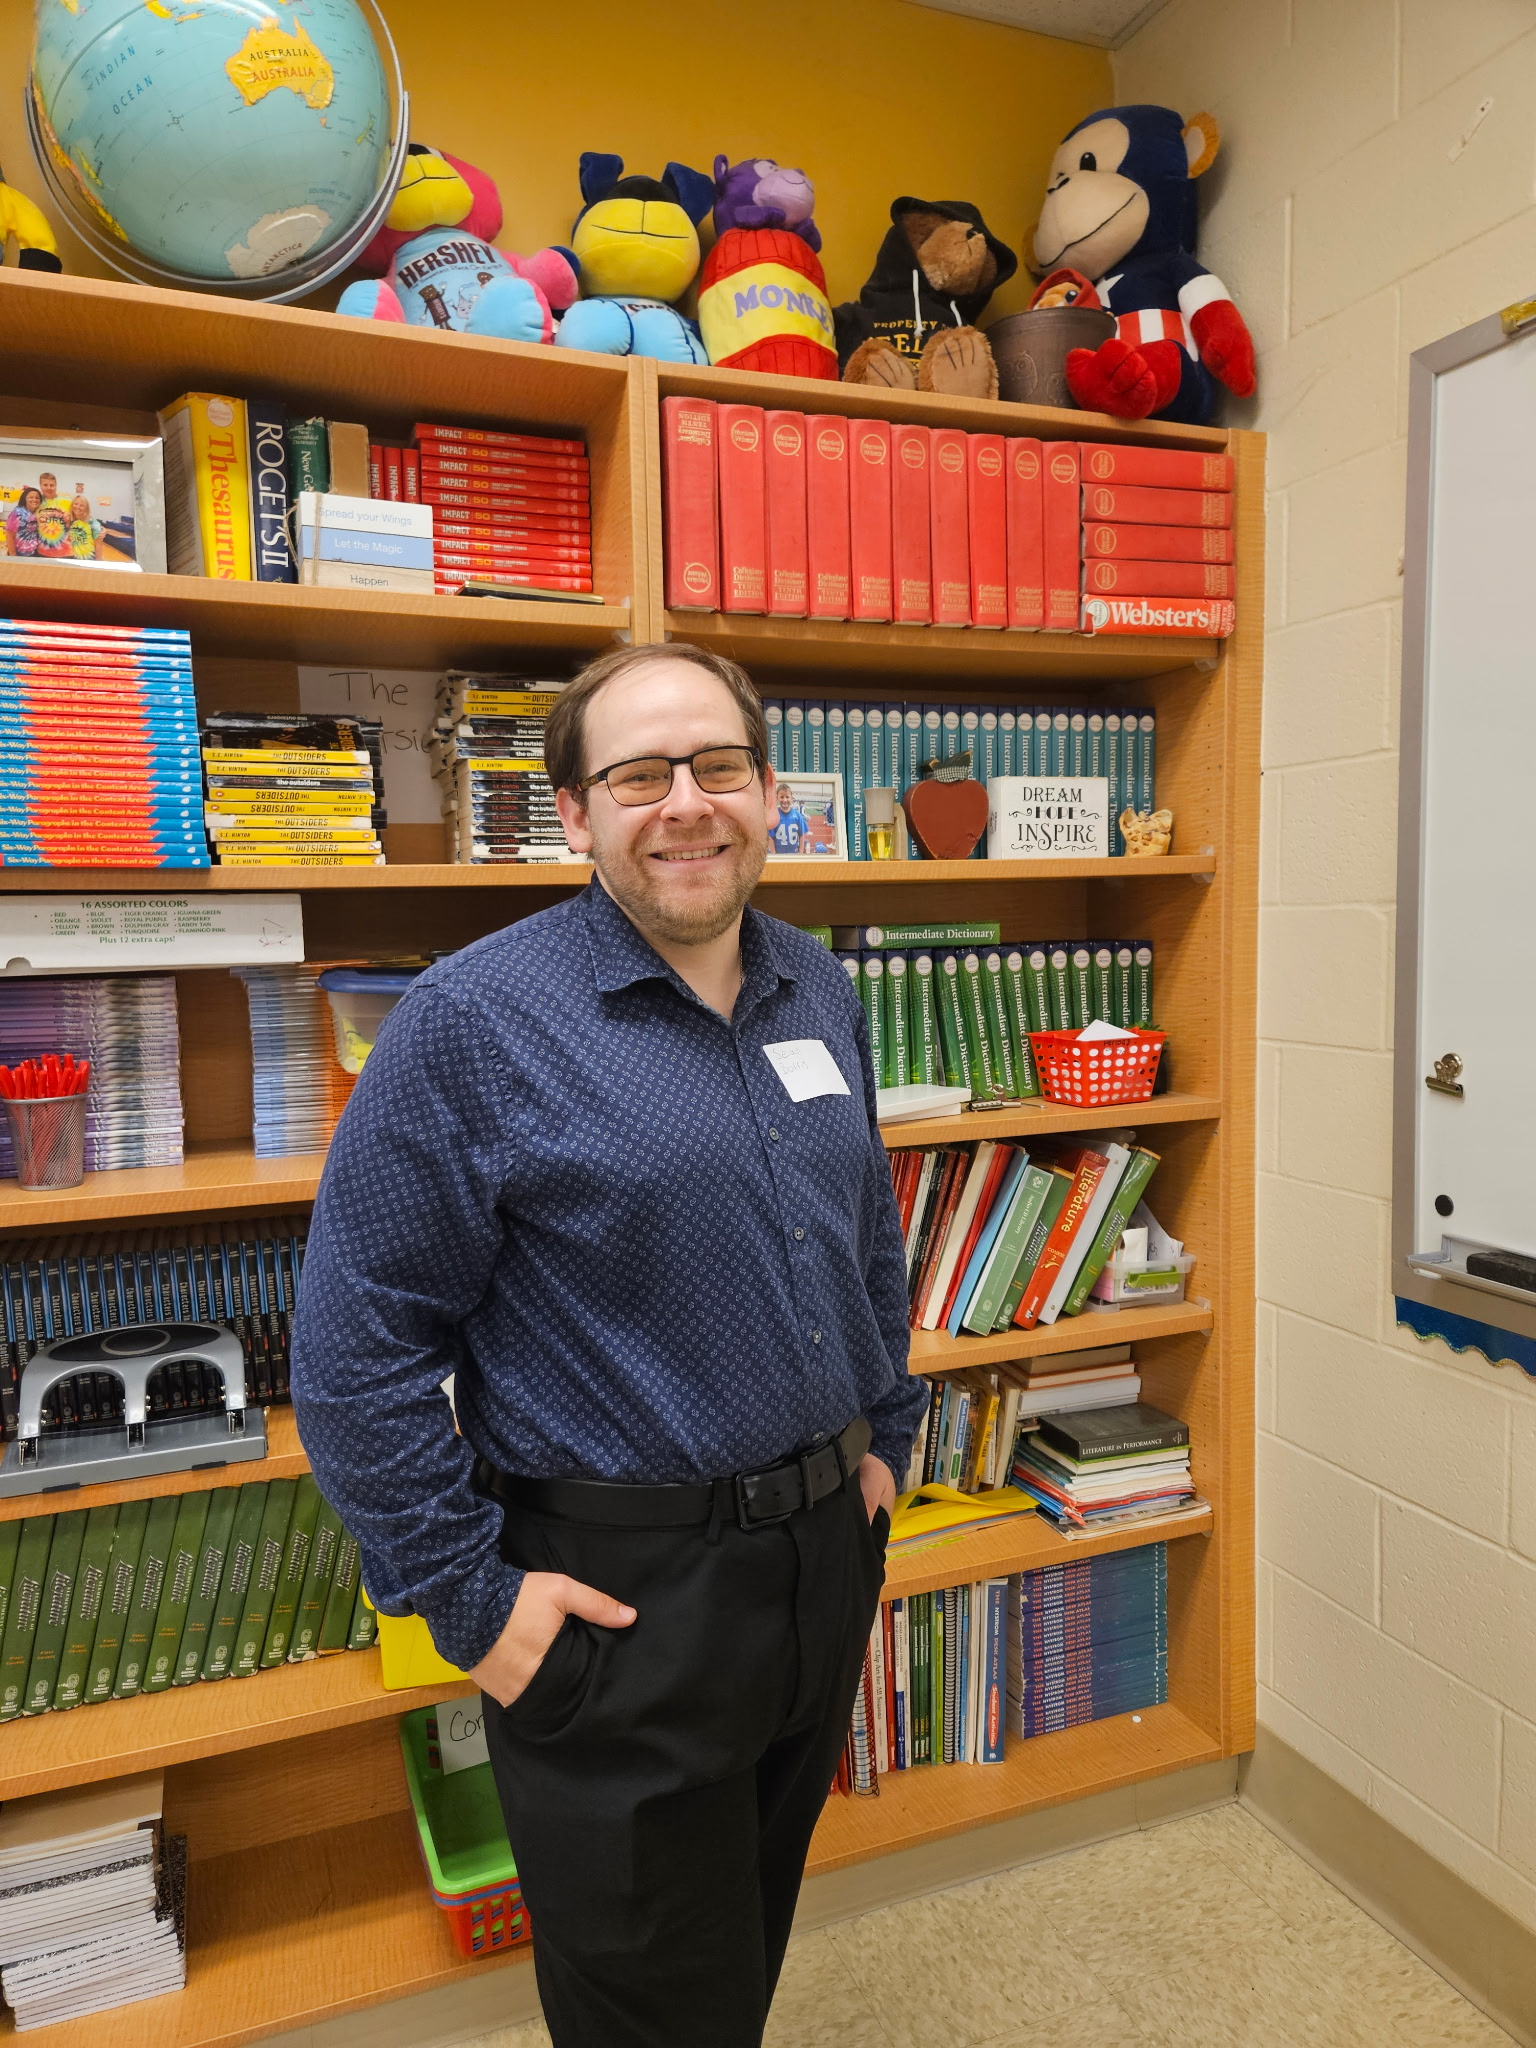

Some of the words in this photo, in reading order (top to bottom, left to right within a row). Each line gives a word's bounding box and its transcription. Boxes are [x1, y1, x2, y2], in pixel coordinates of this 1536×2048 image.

[250, 48, 309, 61] AUSTRALIA
[95, 45, 136, 86] INDIAN
[252, 66, 316, 83] AUSTRALIA
[112, 75, 153, 115] OCEAN
[397, 241, 497, 289] HERSHEY
[734, 283, 832, 335] MONKE
[434, 427, 463, 440] IMPACT
[467, 432, 484, 441] 50
[439, 444, 468, 456] IMPACT
[471, 448, 489, 457] 50
[301, 450, 312, 473] New
[439, 460, 469, 472] IMPACT
[472, 464, 489, 473] 50
[256, 421, 289, 548] ROGET'S
[370, 463, 380, 495] IMPACT
[388, 465, 398, 496] IMPACT
[407, 467, 417, 496] IMPACT
[439, 476, 468, 488] IMPACT
[472, 480, 489, 489] 50
[208, 433, 238, 580] Thesaurus
[439, 492, 468, 504] IMPACT
[473, 496, 489, 505] 50
[319, 507, 354, 521] Spread
[356, 512, 379, 525] your
[381, 512, 413, 526] Wings
[441, 508, 470, 520] IMPACT
[474, 512, 491, 521] 50
[334, 538, 352, 549] Let
[353, 540, 370, 551] the
[372, 541, 403, 555] Magic
[261, 550, 289, 568] II
[350, 574, 389, 587] Happen
[1109, 601, 1209, 628] Webster's
[328, 671, 409, 706] The
[531, 694, 557, 703] OUTSID
[283, 752, 326, 761] OUTSIDERS
[853, 731, 863, 800] Intermediate
[287, 767, 330, 775] OUTSIDERS
[1109, 736, 1119, 799] Intermediate
[1143, 736, 1152, 799] Intermediate
[255, 791, 299, 800] OUTSIDERS
[1022, 786, 1084, 804] DREAM
[251, 805, 295, 813] OUTSIDERS
[1035, 806, 1078, 820] HOPE
[285, 818, 328, 826] OUTSIDERS
[853, 802, 863, 857] Thesaurus
[1109, 801, 1118, 853] Thesaurus
[290, 831, 333, 840] OUTSIDERS
[775, 823, 799, 846] 46
[1017, 822, 1096, 851] INSPIRE
[295, 843, 339, 852] OUTSIDERS
[82, 857, 90, 866] in
[101, 857, 136, 866] Content
[300, 857, 343, 865] OUTSIDERS
[80, 901, 92, 909] 16
[94, 900, 147, 909] ASSORTED
[148, 900, 189, 908] COLORS
[99, 936, 117, 944] Plus
[154, 935, 176, 945] caps!
[886, 928, 945, 940] Intermediate
[947, 928, 996, 940] Dictionary
[871, 981, 882, 1046] Intermediate
[895, 979, 905, 1046] Intermediate
[921, 977, 931, 1042] Intermediate
[950, 977, 964, 1041] Intermediate
[971, 975, 985, 1038] Intermediate
[993, 975, 1007, 1038] Intermediate
[1001, 1039, 1015, 1092] Dictionary
[1013, 974, 1027, 1039] Intermediate
[1020, 1040, 1033, 1091] Dictionary
[1061, 1165, 1098, 1233] Literature
[933, 1408, 941, 1431] GAMES
[1082, 1444, 1115, 1455] LITERATURE
[1123, 1438, 1162, 1450] PERFORMANCE
